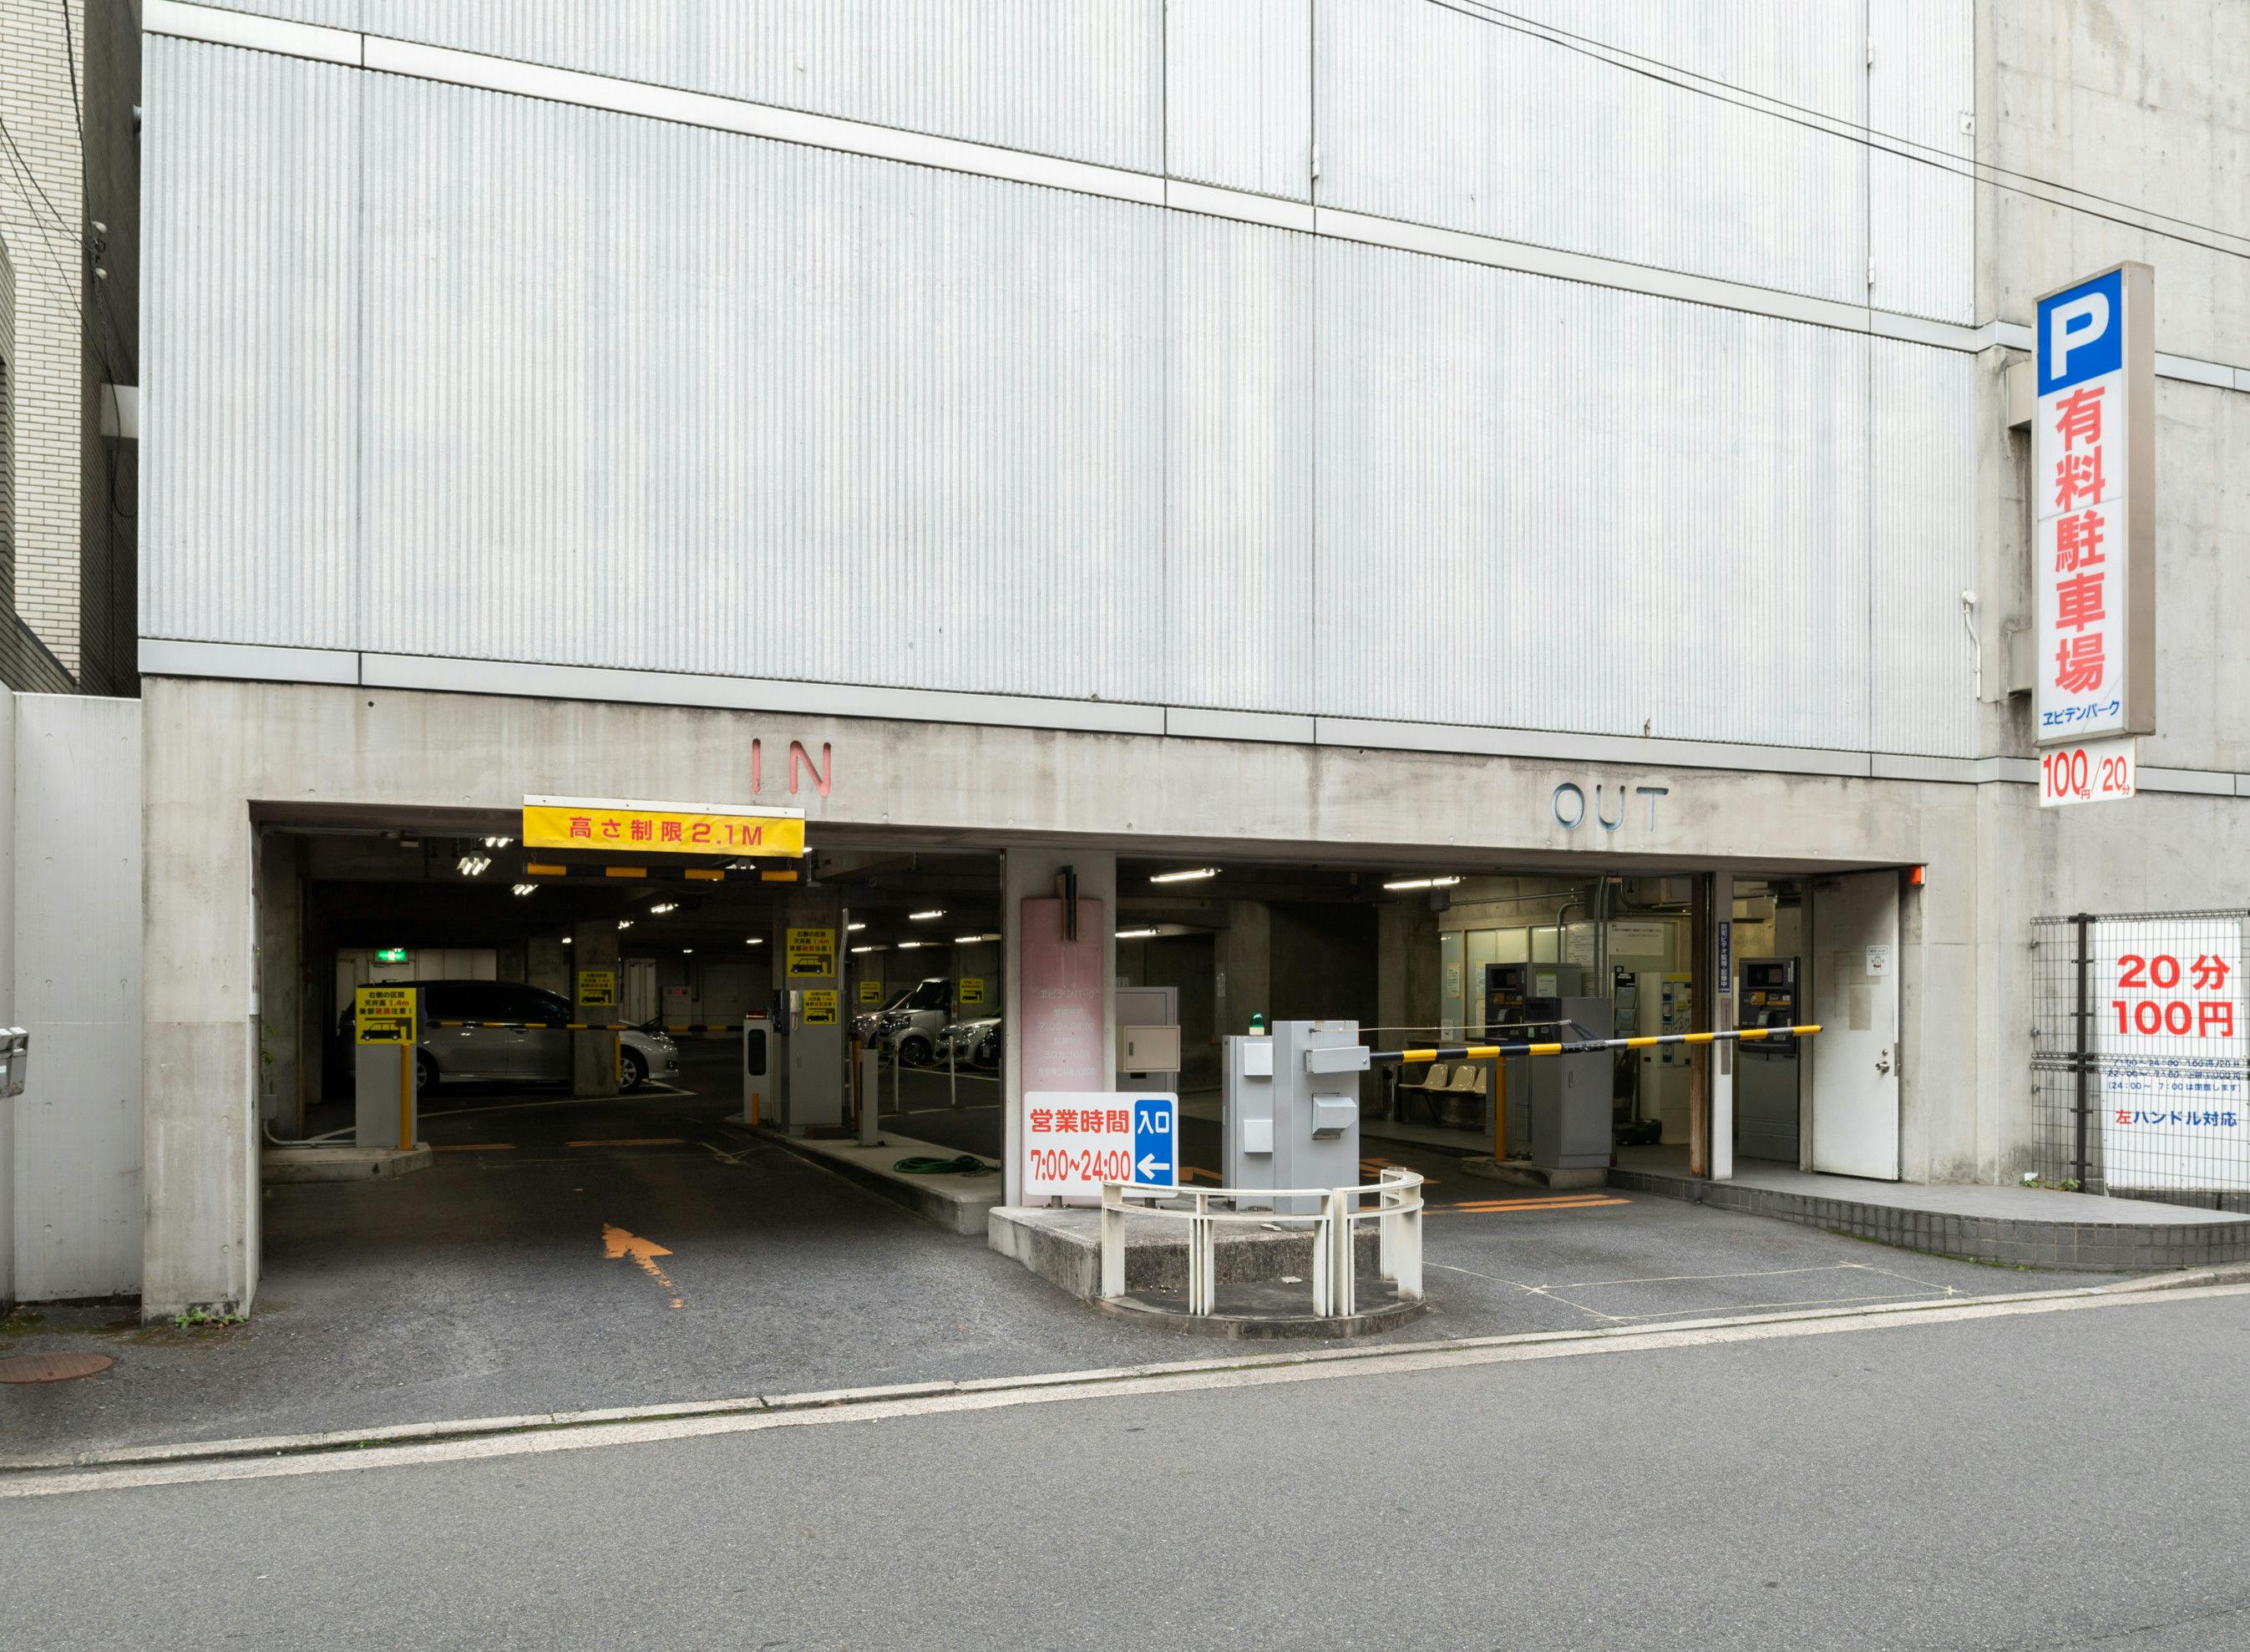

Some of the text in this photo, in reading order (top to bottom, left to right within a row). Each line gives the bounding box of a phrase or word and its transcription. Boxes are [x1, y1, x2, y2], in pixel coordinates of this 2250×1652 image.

[2050, 290, 2109, 380] P
[2055, 385, 2106, 694] 有料駐車場
[752, 737, 832, 798] IN
[1551, 783, 1670, 832] OUT
[2117, 954, 2230, 990] 20分
[2112, 1001, 2234, 1037] 100円
[1030, 1108, 1129, 1134] 営業時間
[1137, 1110, 1169, 1134] 入口
[2116, 1109, 2237, 1128] 左ハンドル対応
